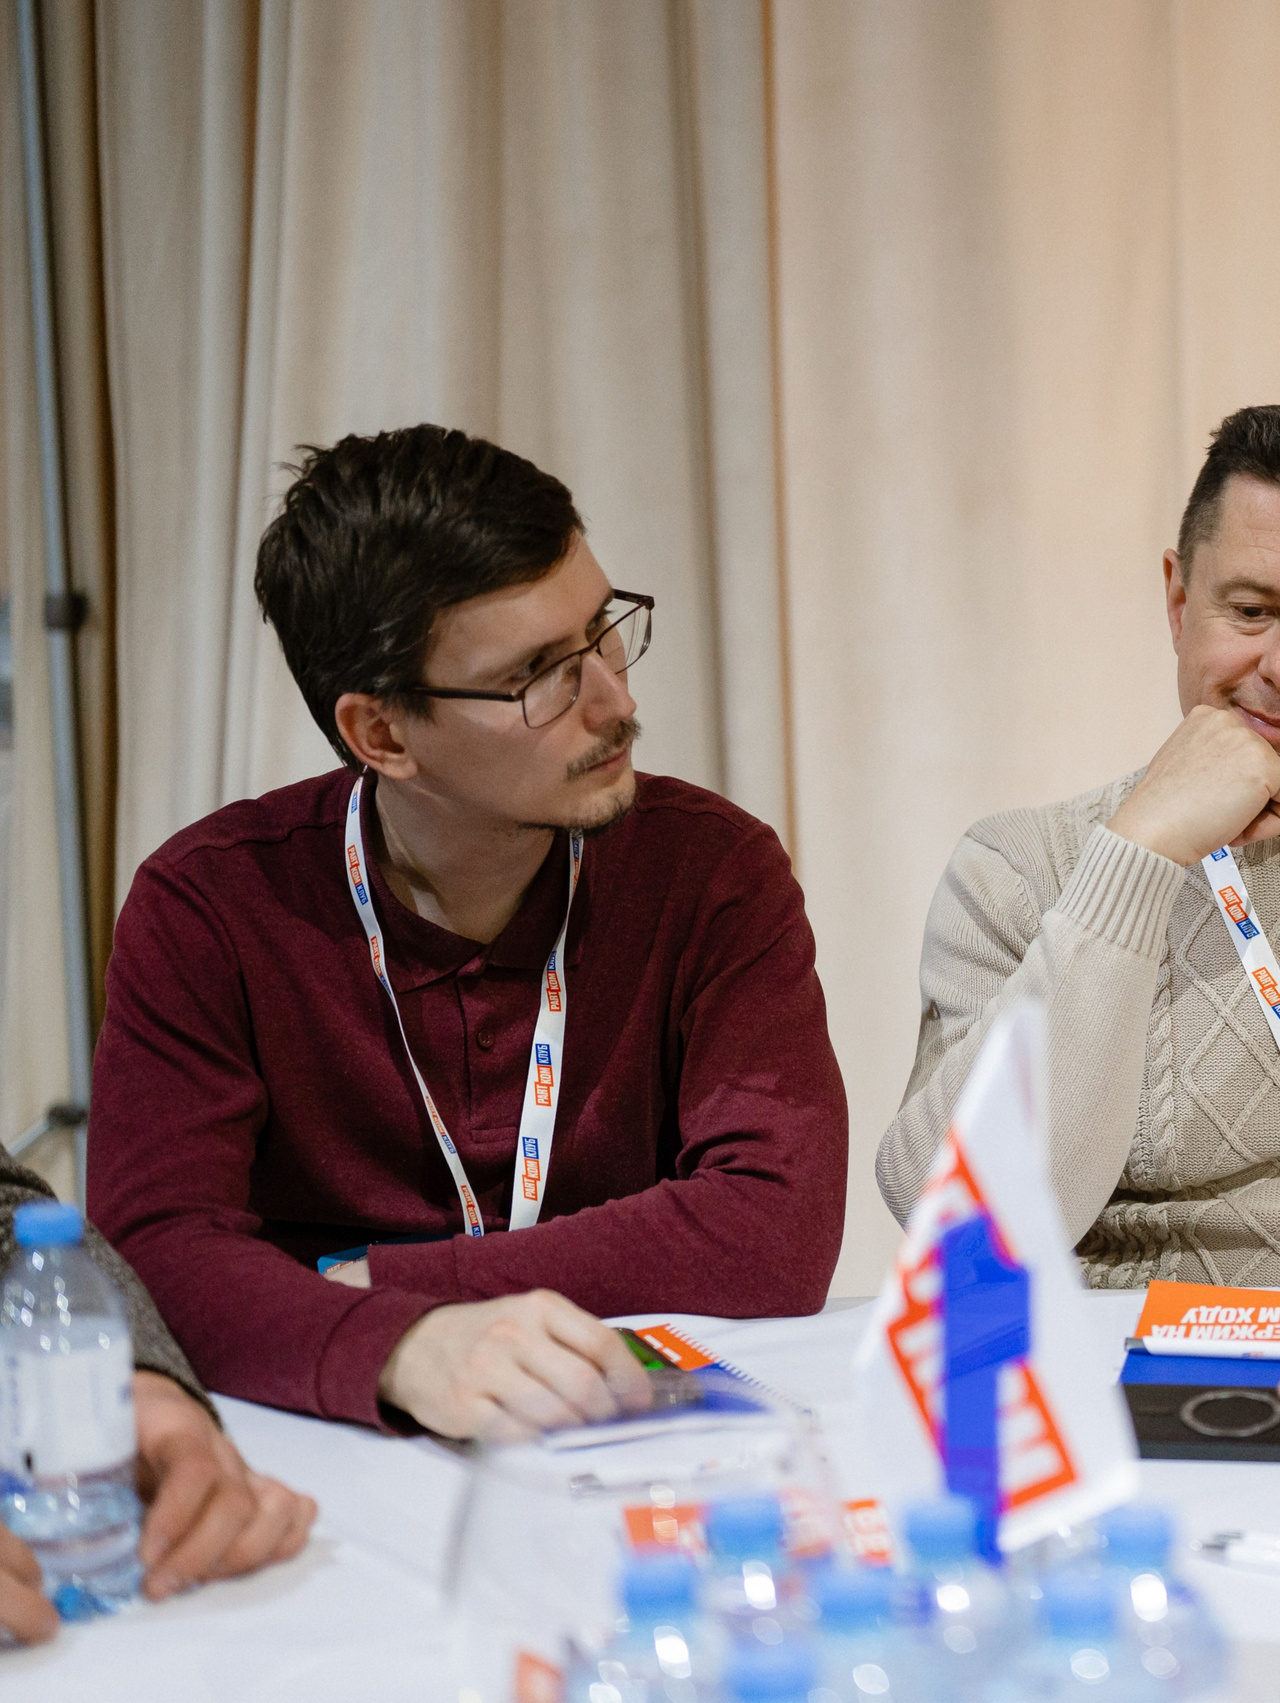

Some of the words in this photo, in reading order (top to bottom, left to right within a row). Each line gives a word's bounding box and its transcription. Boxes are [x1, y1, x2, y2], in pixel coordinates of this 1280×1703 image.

[549, 991, 560, 1010] PART
[537, 1044, 549, 1064] КЛУБ
[536, 1085, 550, 1104] PART
[524, 1138, 537, 1158] КЛУБ
[524, 1178, 536, 1199] PART
[1181, 1305, 1255, 1324] ХОДУ
